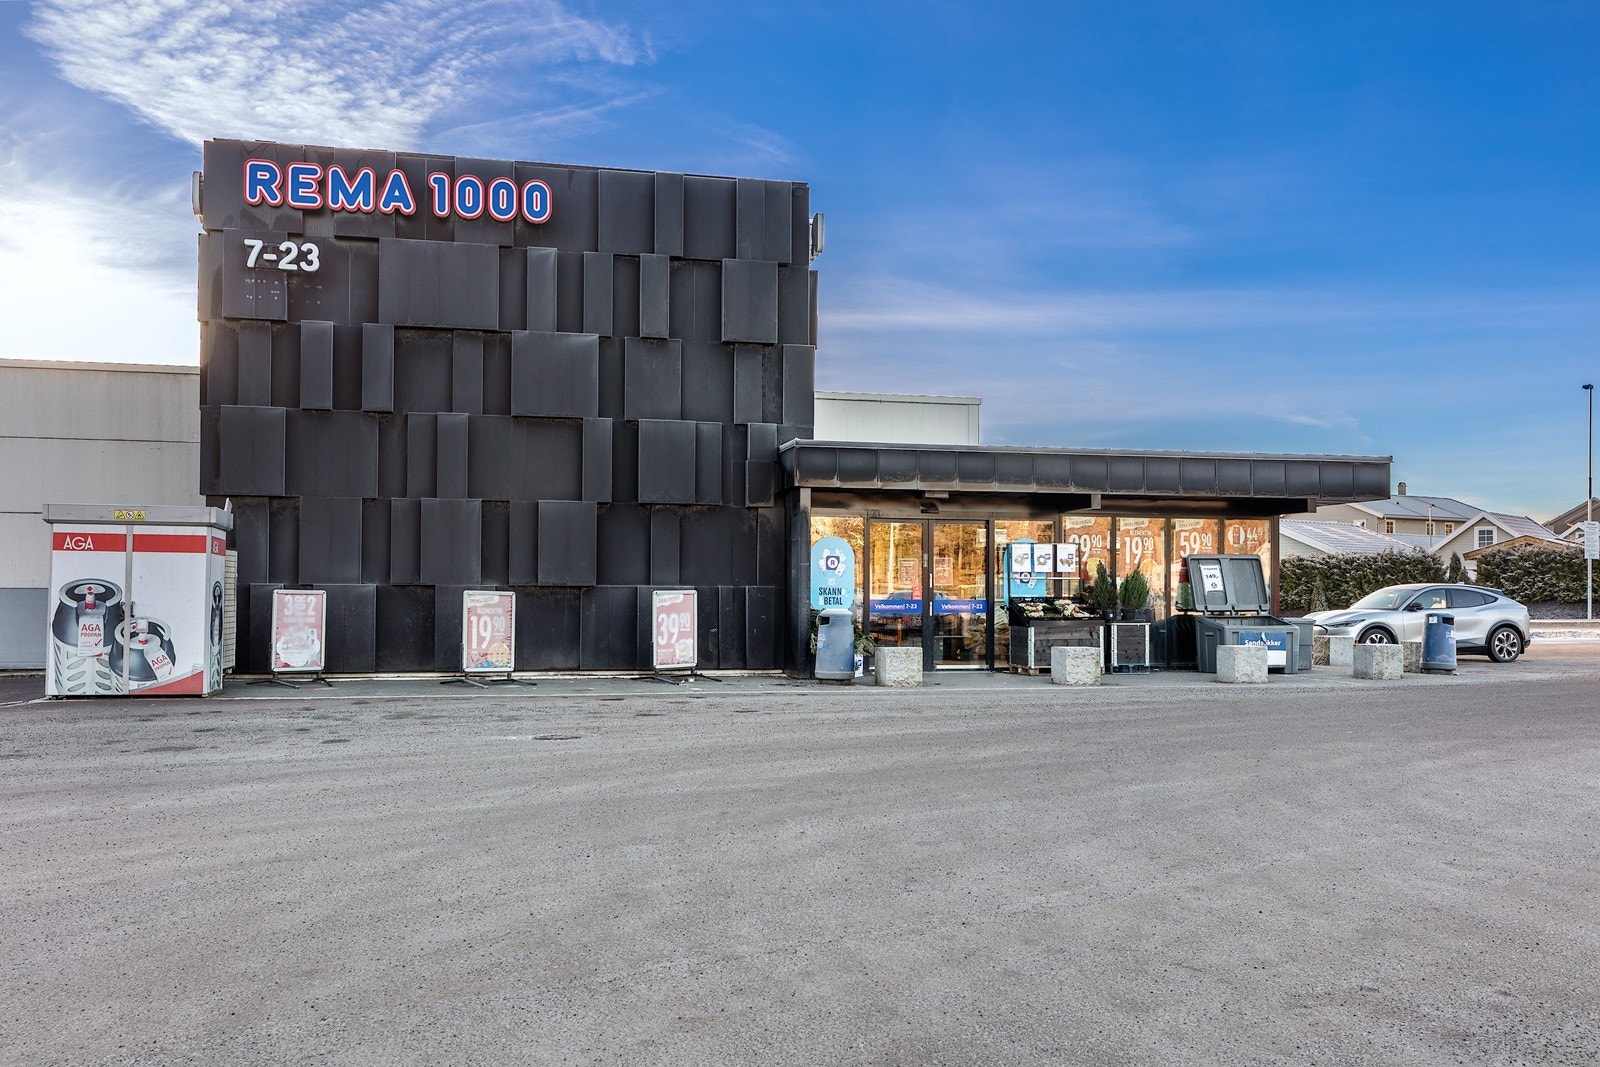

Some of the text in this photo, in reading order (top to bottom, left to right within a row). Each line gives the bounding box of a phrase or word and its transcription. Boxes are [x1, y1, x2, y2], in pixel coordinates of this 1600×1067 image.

[244, 159, 552, 224] REMA 1000
[244, 239, 320, 272] 7-23
[63, 535, 94, 550] AGA
[1091, 535, 1102, 548] 90
[1125, 536, 1154, 565] 19 90
[1180, 532, 1200, 558] 59
[1201, 533, 1212, 547] 90
[819, 587, 842, 596] SKANN
[284, 594, 293, 616] 3
[307, 595, 316, 616] 2
[81, 623, 101, 632] AGA
[471, 615, 505, 650] 19 90
[658, 612, 691, 646] 39 90
[151, 654, 168, 667] AGA
